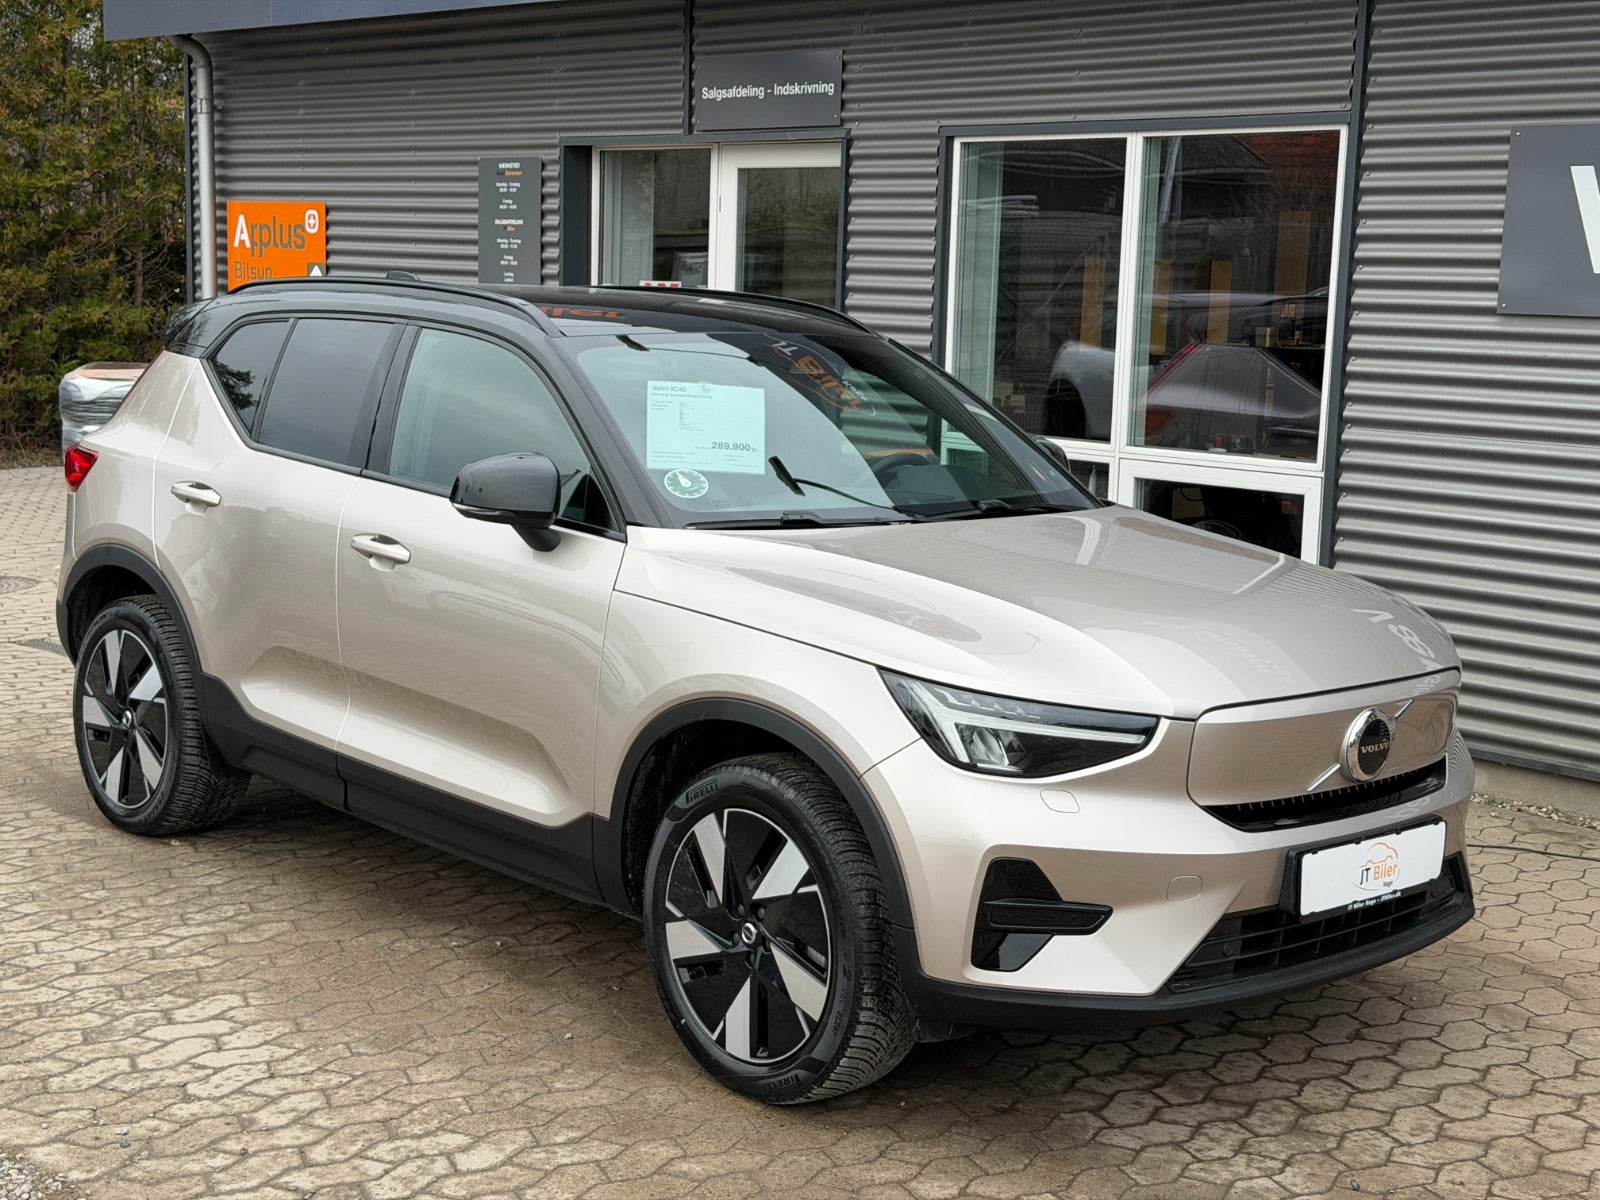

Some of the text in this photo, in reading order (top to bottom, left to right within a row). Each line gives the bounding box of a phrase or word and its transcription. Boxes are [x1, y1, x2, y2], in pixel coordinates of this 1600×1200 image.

[701, 85, 765, 101] Salgsafdeling
[773, 80, 835, 96] Indskrivning
[711, 441, 751, 451] 289.900
[1359, 862, 1398, 886] JT Biler
